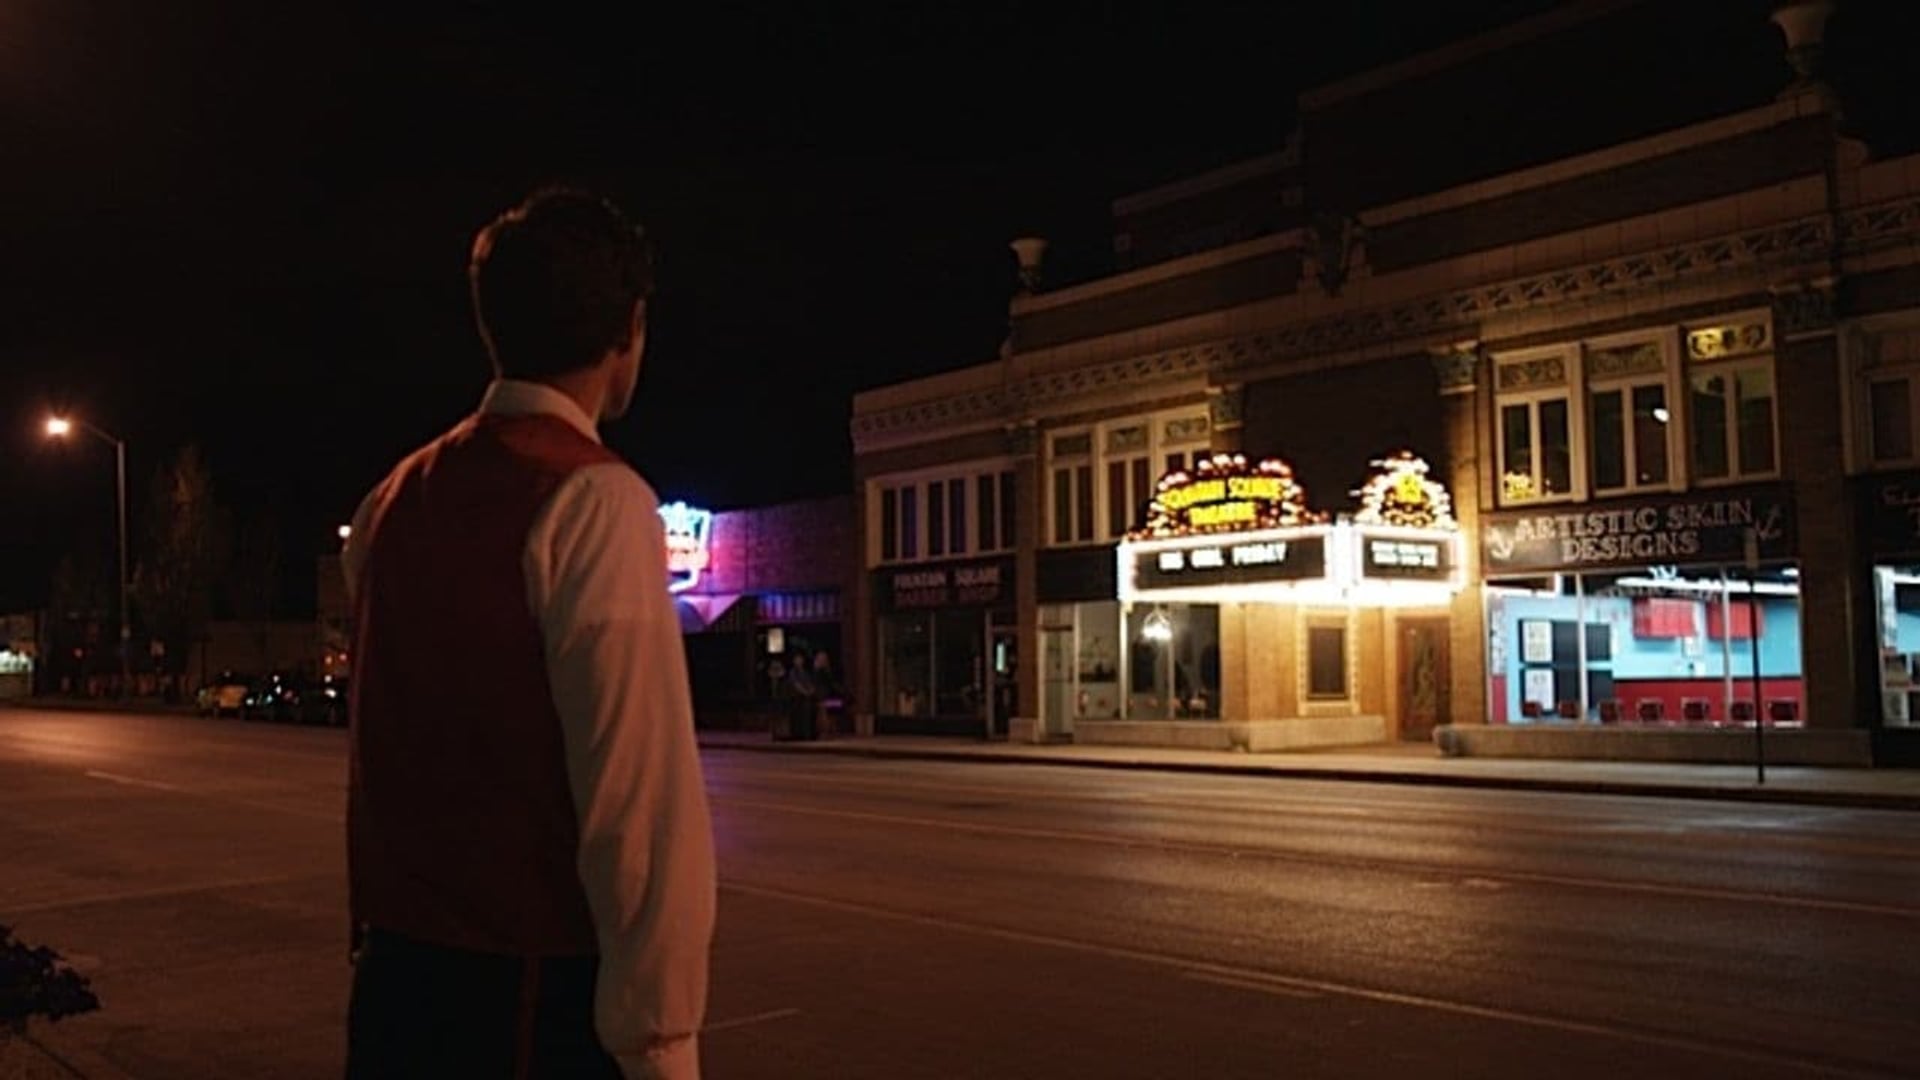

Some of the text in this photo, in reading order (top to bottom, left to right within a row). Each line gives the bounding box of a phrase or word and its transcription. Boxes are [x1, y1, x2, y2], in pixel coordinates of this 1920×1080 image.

[1514, 499, 1752, 541] ARTISTIC SKIN
[1561, 530, 1699, 562] DESIGNS
